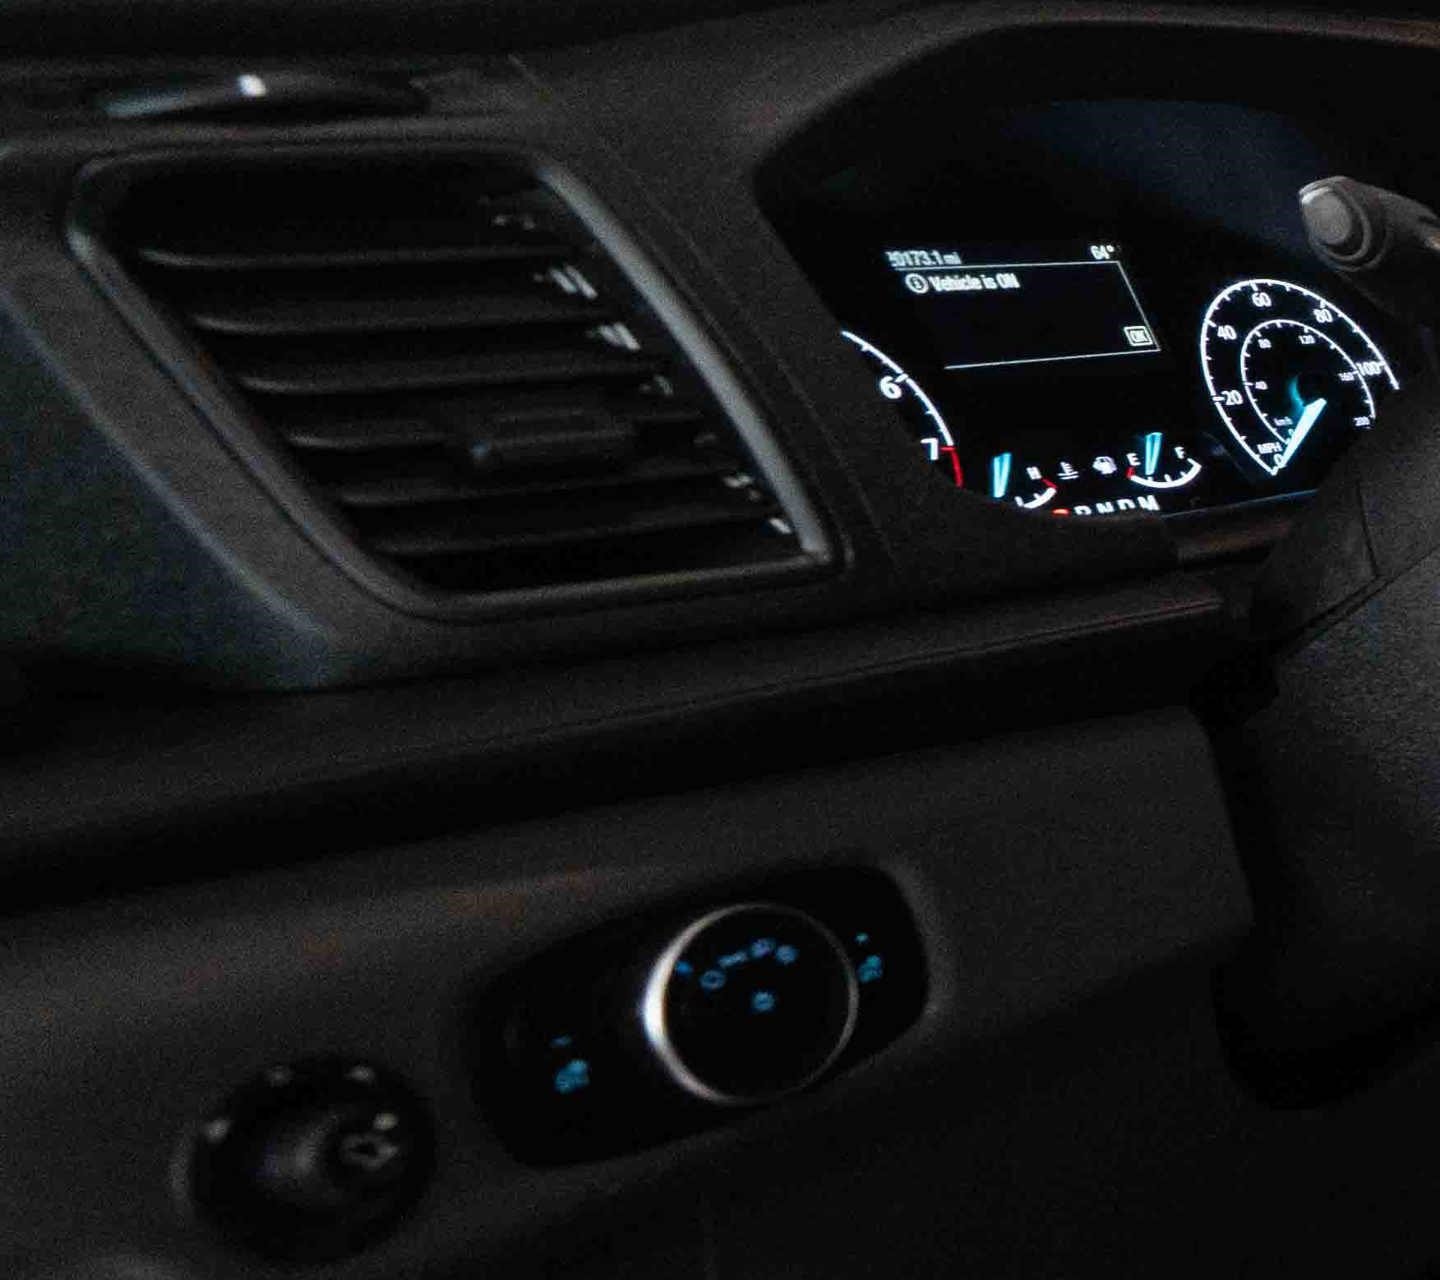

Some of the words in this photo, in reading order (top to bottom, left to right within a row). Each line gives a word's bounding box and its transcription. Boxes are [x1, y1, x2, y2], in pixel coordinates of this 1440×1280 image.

[929, 274, 982, 293] Vehicle
[983, 275, 997, 290] is
[996, 273, 1020, 290] ON
[1251, 292, 1272, 308] 60
[1312, 308, 1334, 324] 80
[1216, 325, 1237, 341] 40
[1356, 361, 1382, 376] 100
[879, 376, 902, 400] 6
[1221, 390, 1244, 406] 20
[920, 437, 938, 461] 7
[1126, 452, 1141, 467] E
